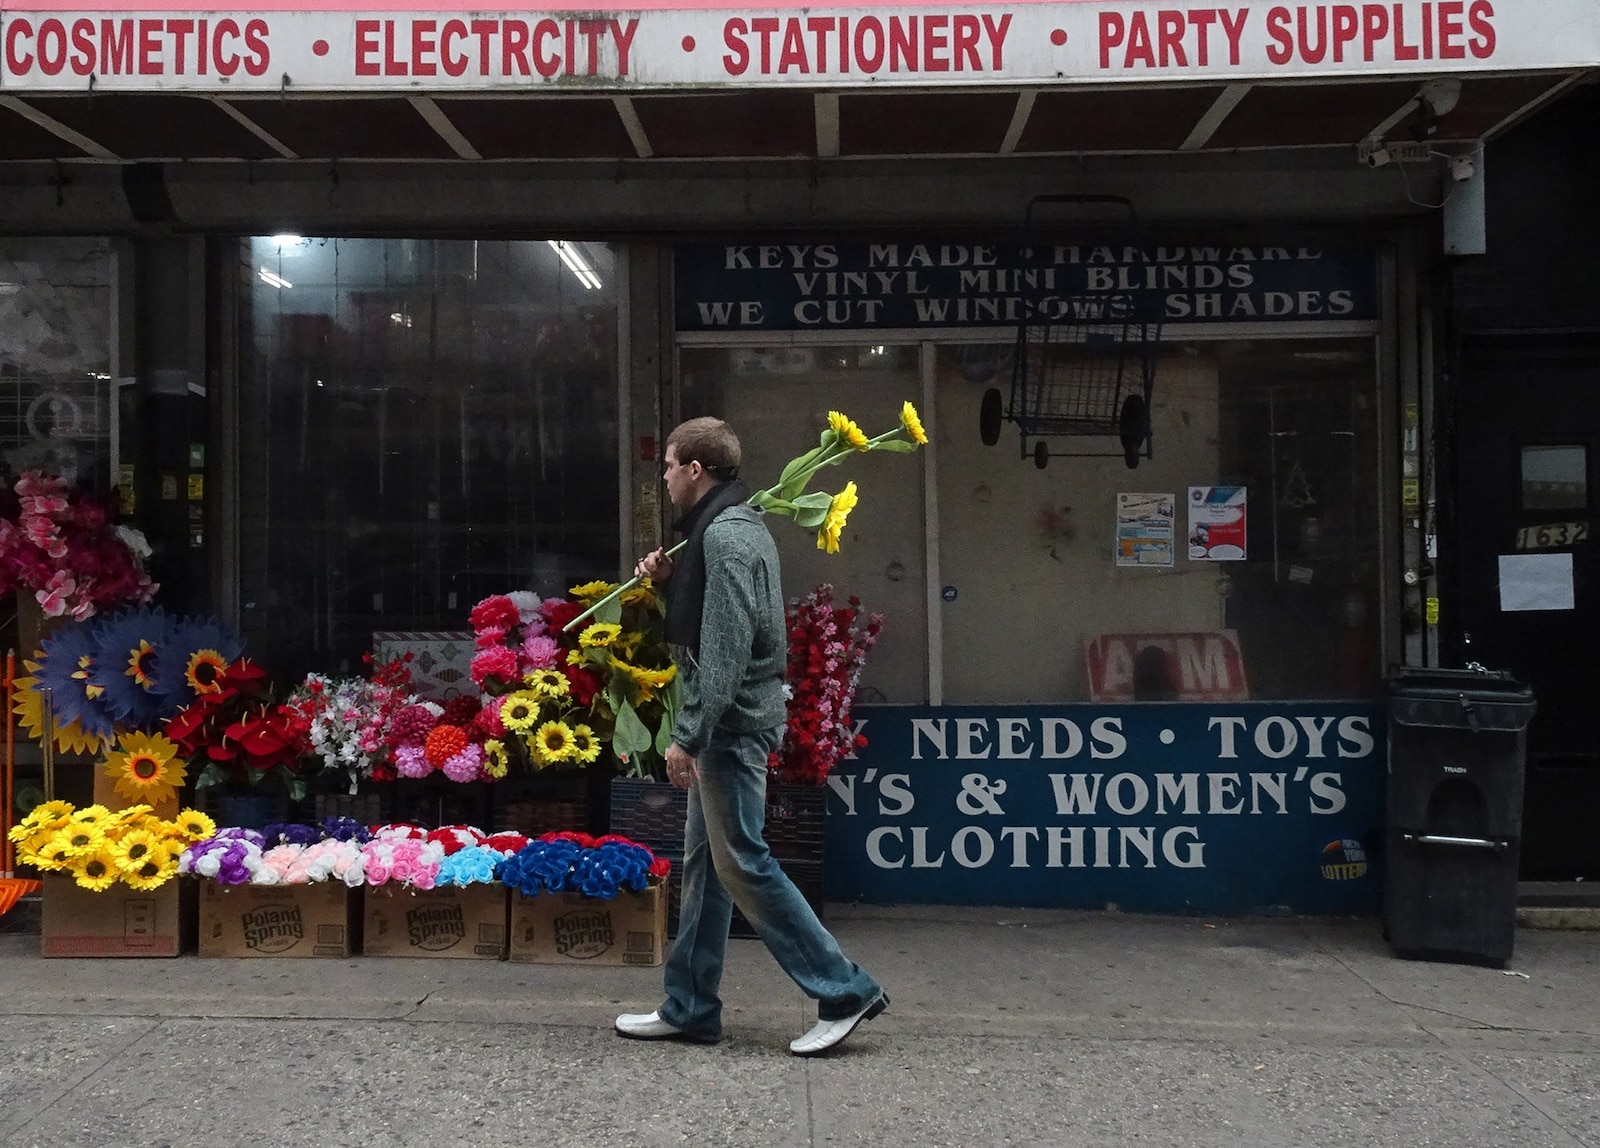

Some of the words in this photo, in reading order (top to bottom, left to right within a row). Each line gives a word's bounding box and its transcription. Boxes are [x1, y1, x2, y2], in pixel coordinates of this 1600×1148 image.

[6, 18, 270, 76] COSMETICS
[355, 18, 640, 77] ELECTRCITY
[723, 14, 1012, 75] STATIONERY
[1099, 8, 1249, 69] PARTY
[1266, 1, 1496, 65] SUPPLIES
[725, 245, 839, 269] KEYS
[868, 244, 998, 267] MADE
[793, 270, 930, 296] VINYL
[958, 268, 1056, 294] MINI
[1086, 263, 1255, 290] BLINDS
[697, 300, 765, 325] WE
[793, 299, 884, 324] CUT
[1164, 289, 1355, 318] SHADES
[1522, 522, 1590, 549] 1632
[911, 717, 1127, 759] NEEDS
[1207, 716, 1375, 759] TOYS
[955, 773, 1007, 816] &
[1049, 766, 1347, 815] WOMEN'S
[866, 826, 1206, 869] CLOTHING
[241, 904, 302, 931] Poland
[406, 903, 464, 927] Poland
[553, 910, 613, 935] Poland
[244, 922, 304, 949] Spring
[408, 921, 465, 946] Spring
[555, 928, 615, 954] Spring
